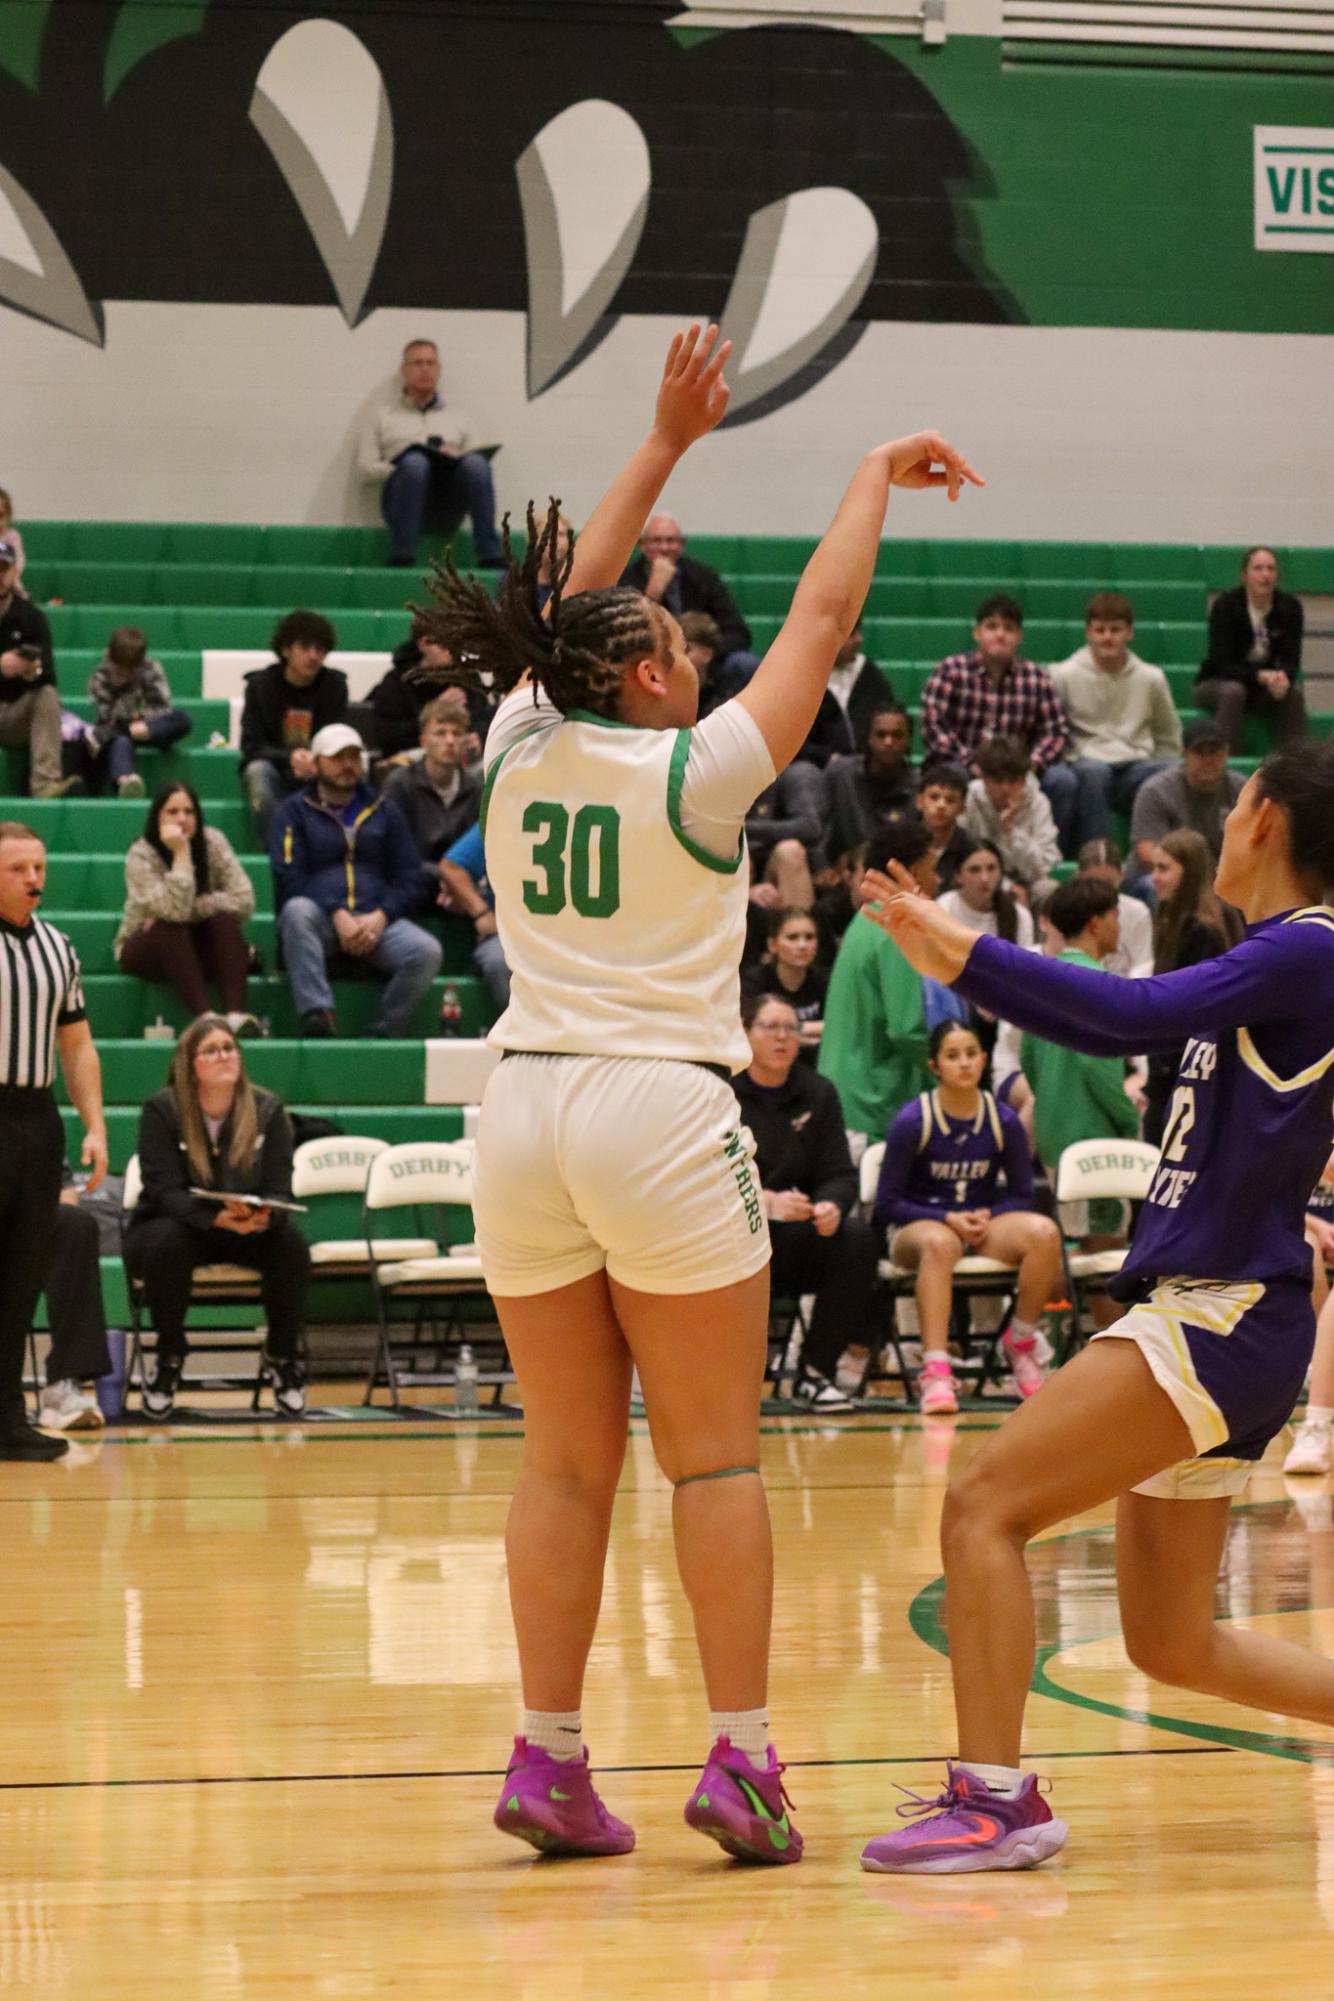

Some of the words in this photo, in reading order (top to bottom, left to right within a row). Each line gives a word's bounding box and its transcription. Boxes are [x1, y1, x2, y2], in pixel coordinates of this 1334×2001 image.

[522, 801, 621, 918] 30
[388, 1157, 470, 1179] DERBY
[1077, 1153, 1155, 1175] DERBY
